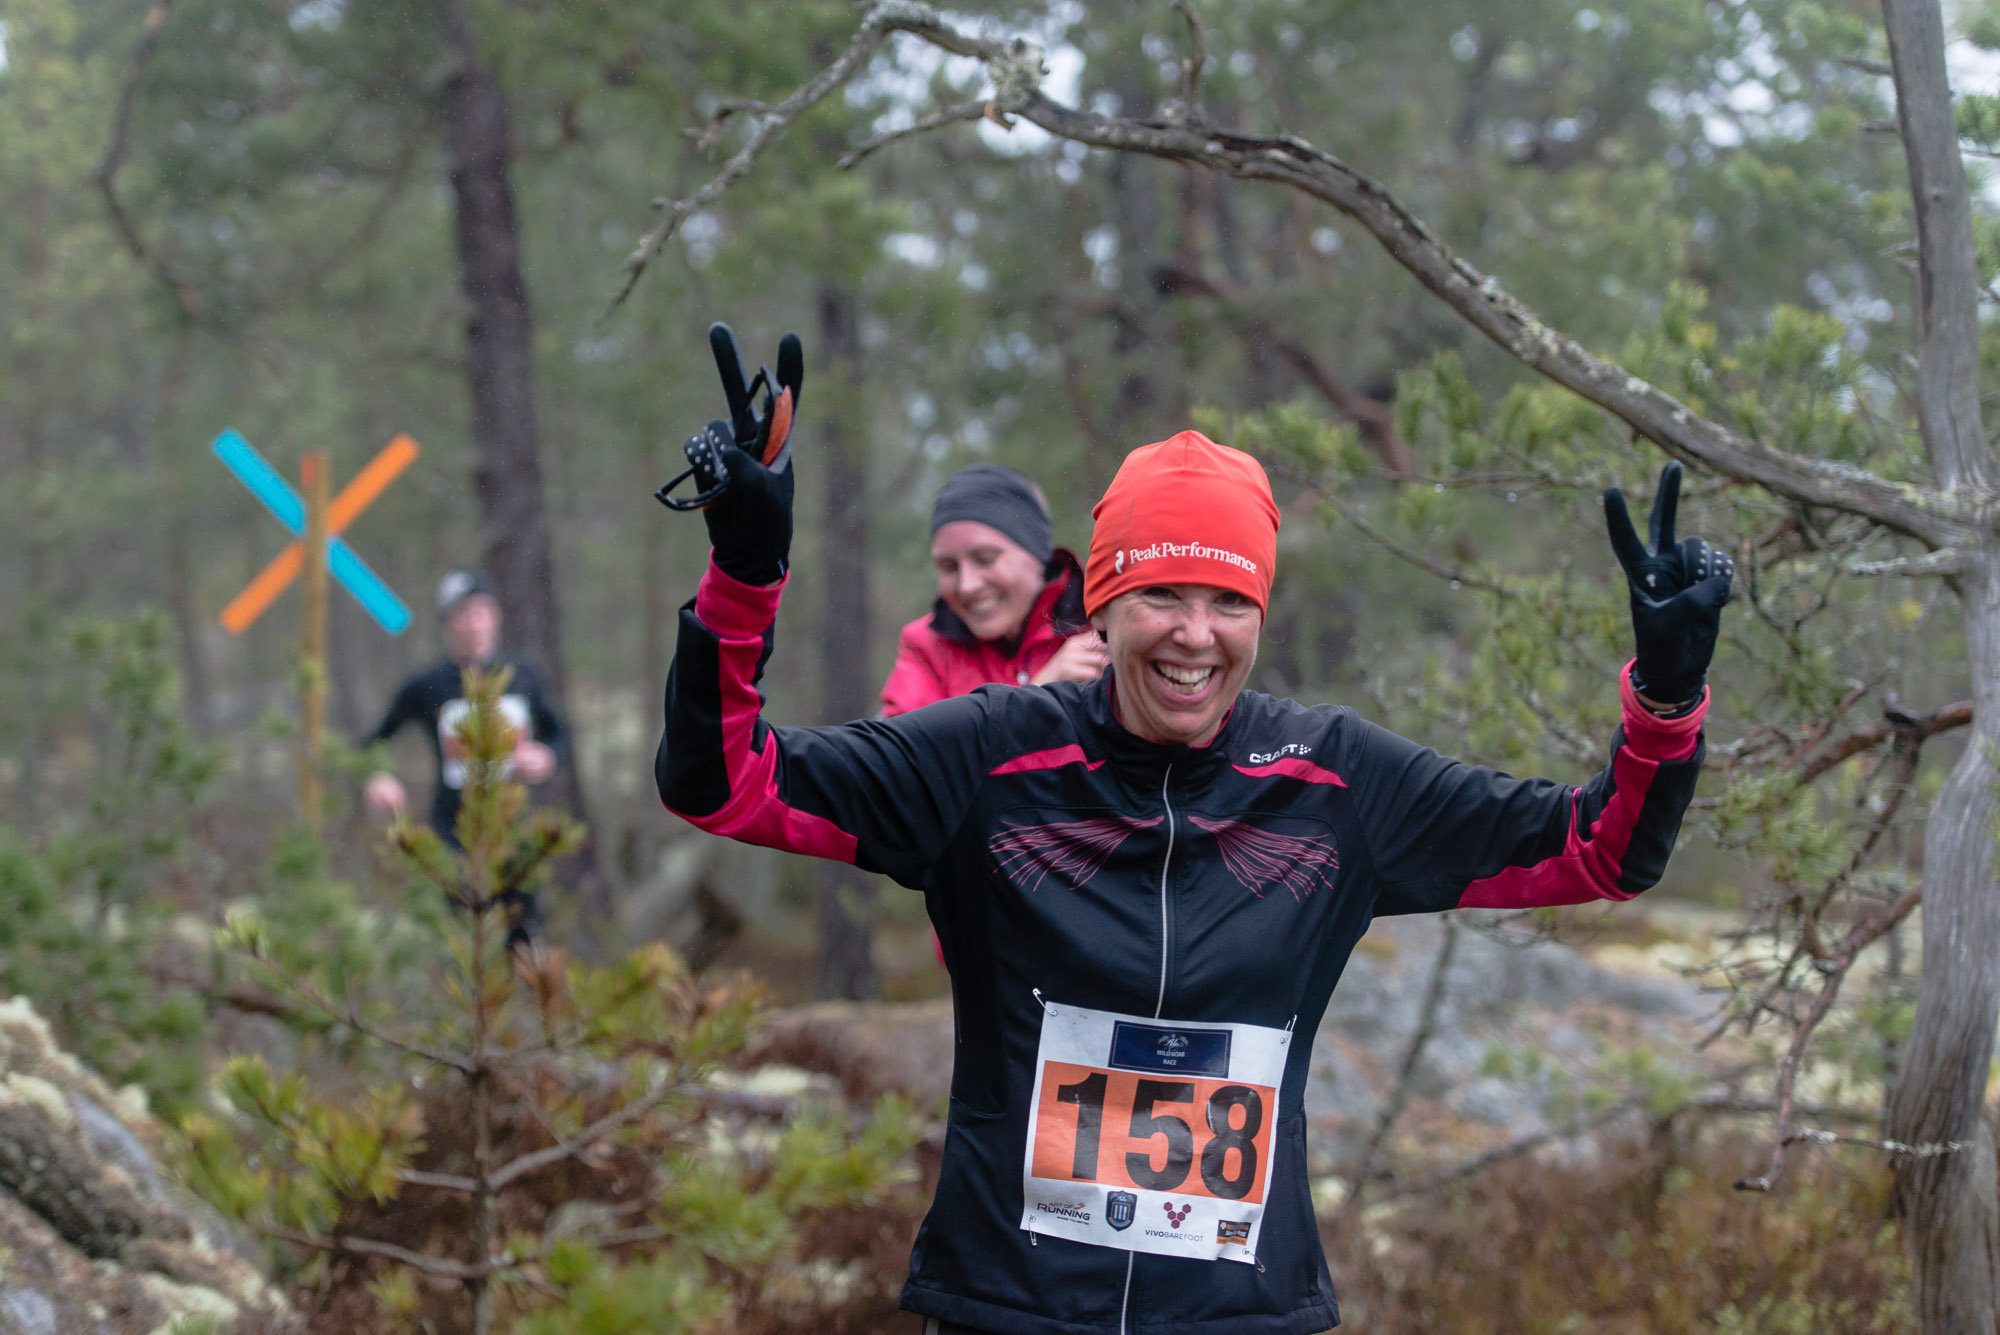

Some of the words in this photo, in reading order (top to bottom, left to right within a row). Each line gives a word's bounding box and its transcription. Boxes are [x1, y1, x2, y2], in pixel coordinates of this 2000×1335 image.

[1129, 541, 1258, 574] PeakPerformance
[1249, 744, 1298, 763] CRAFT
[1057, 1072, 1263, 1200] 158
[1037, 1202, 1091, 1221] RUNNING
[1145, 1229, 1204, 1242] VIVOBAREFOOT
